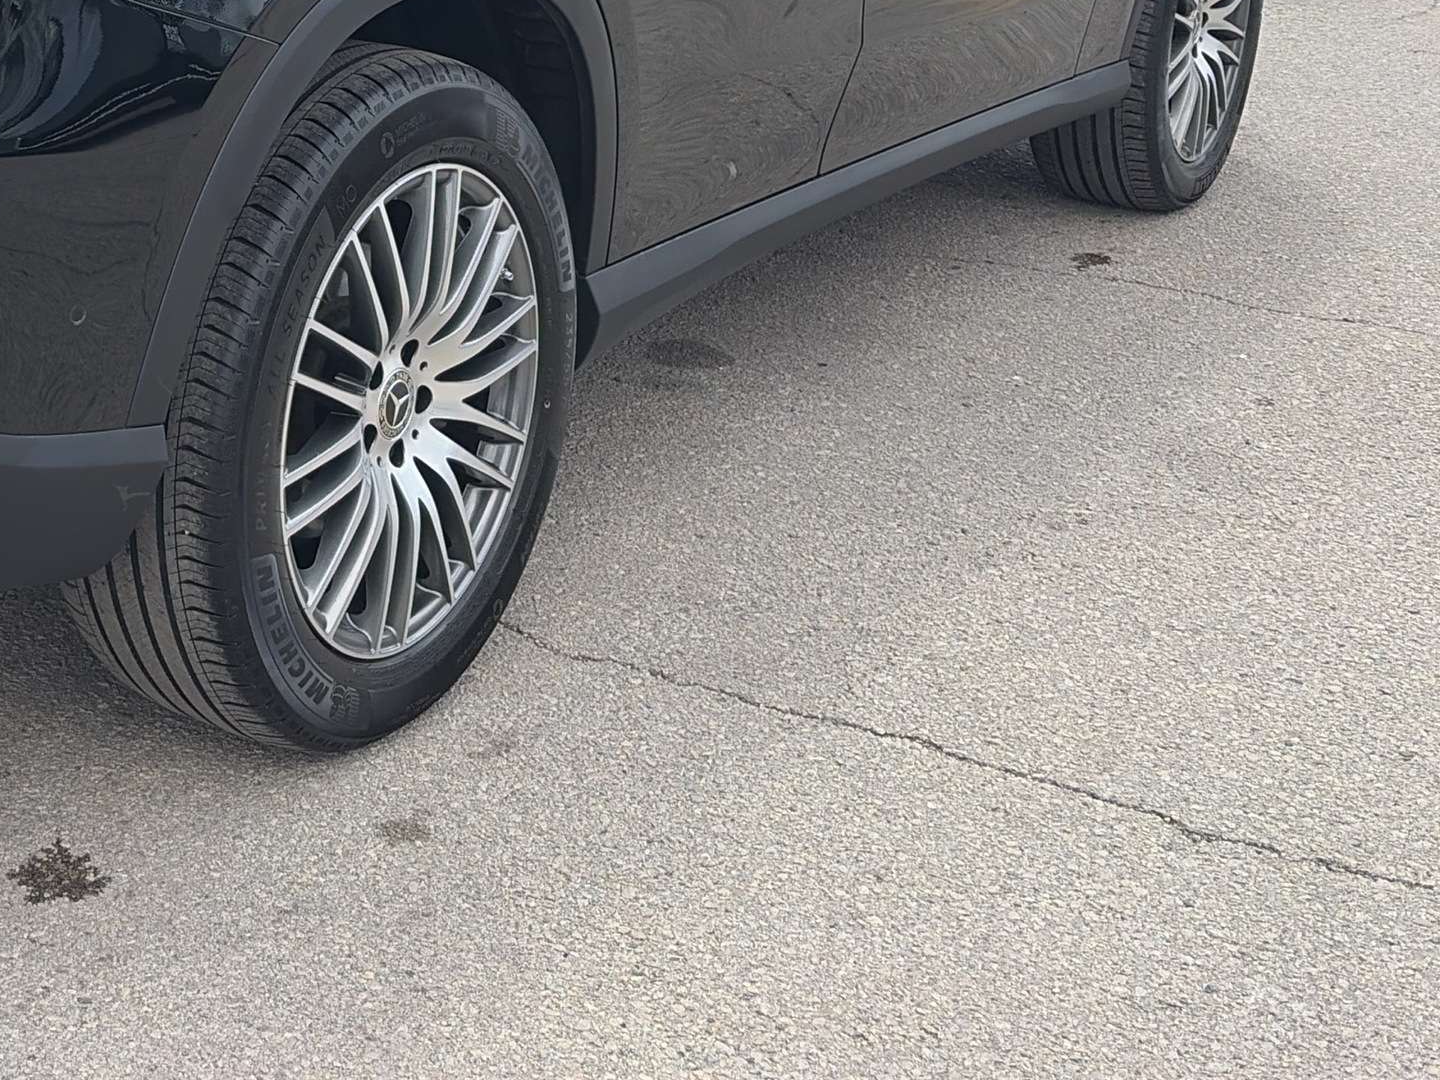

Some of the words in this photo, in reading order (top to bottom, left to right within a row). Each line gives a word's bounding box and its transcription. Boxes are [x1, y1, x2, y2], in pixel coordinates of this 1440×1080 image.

[521, 142, 572, 284] MICHELIN
[283, 232, 326, 336] SEASON
[256, 564, 330, 705] MICHELIN
